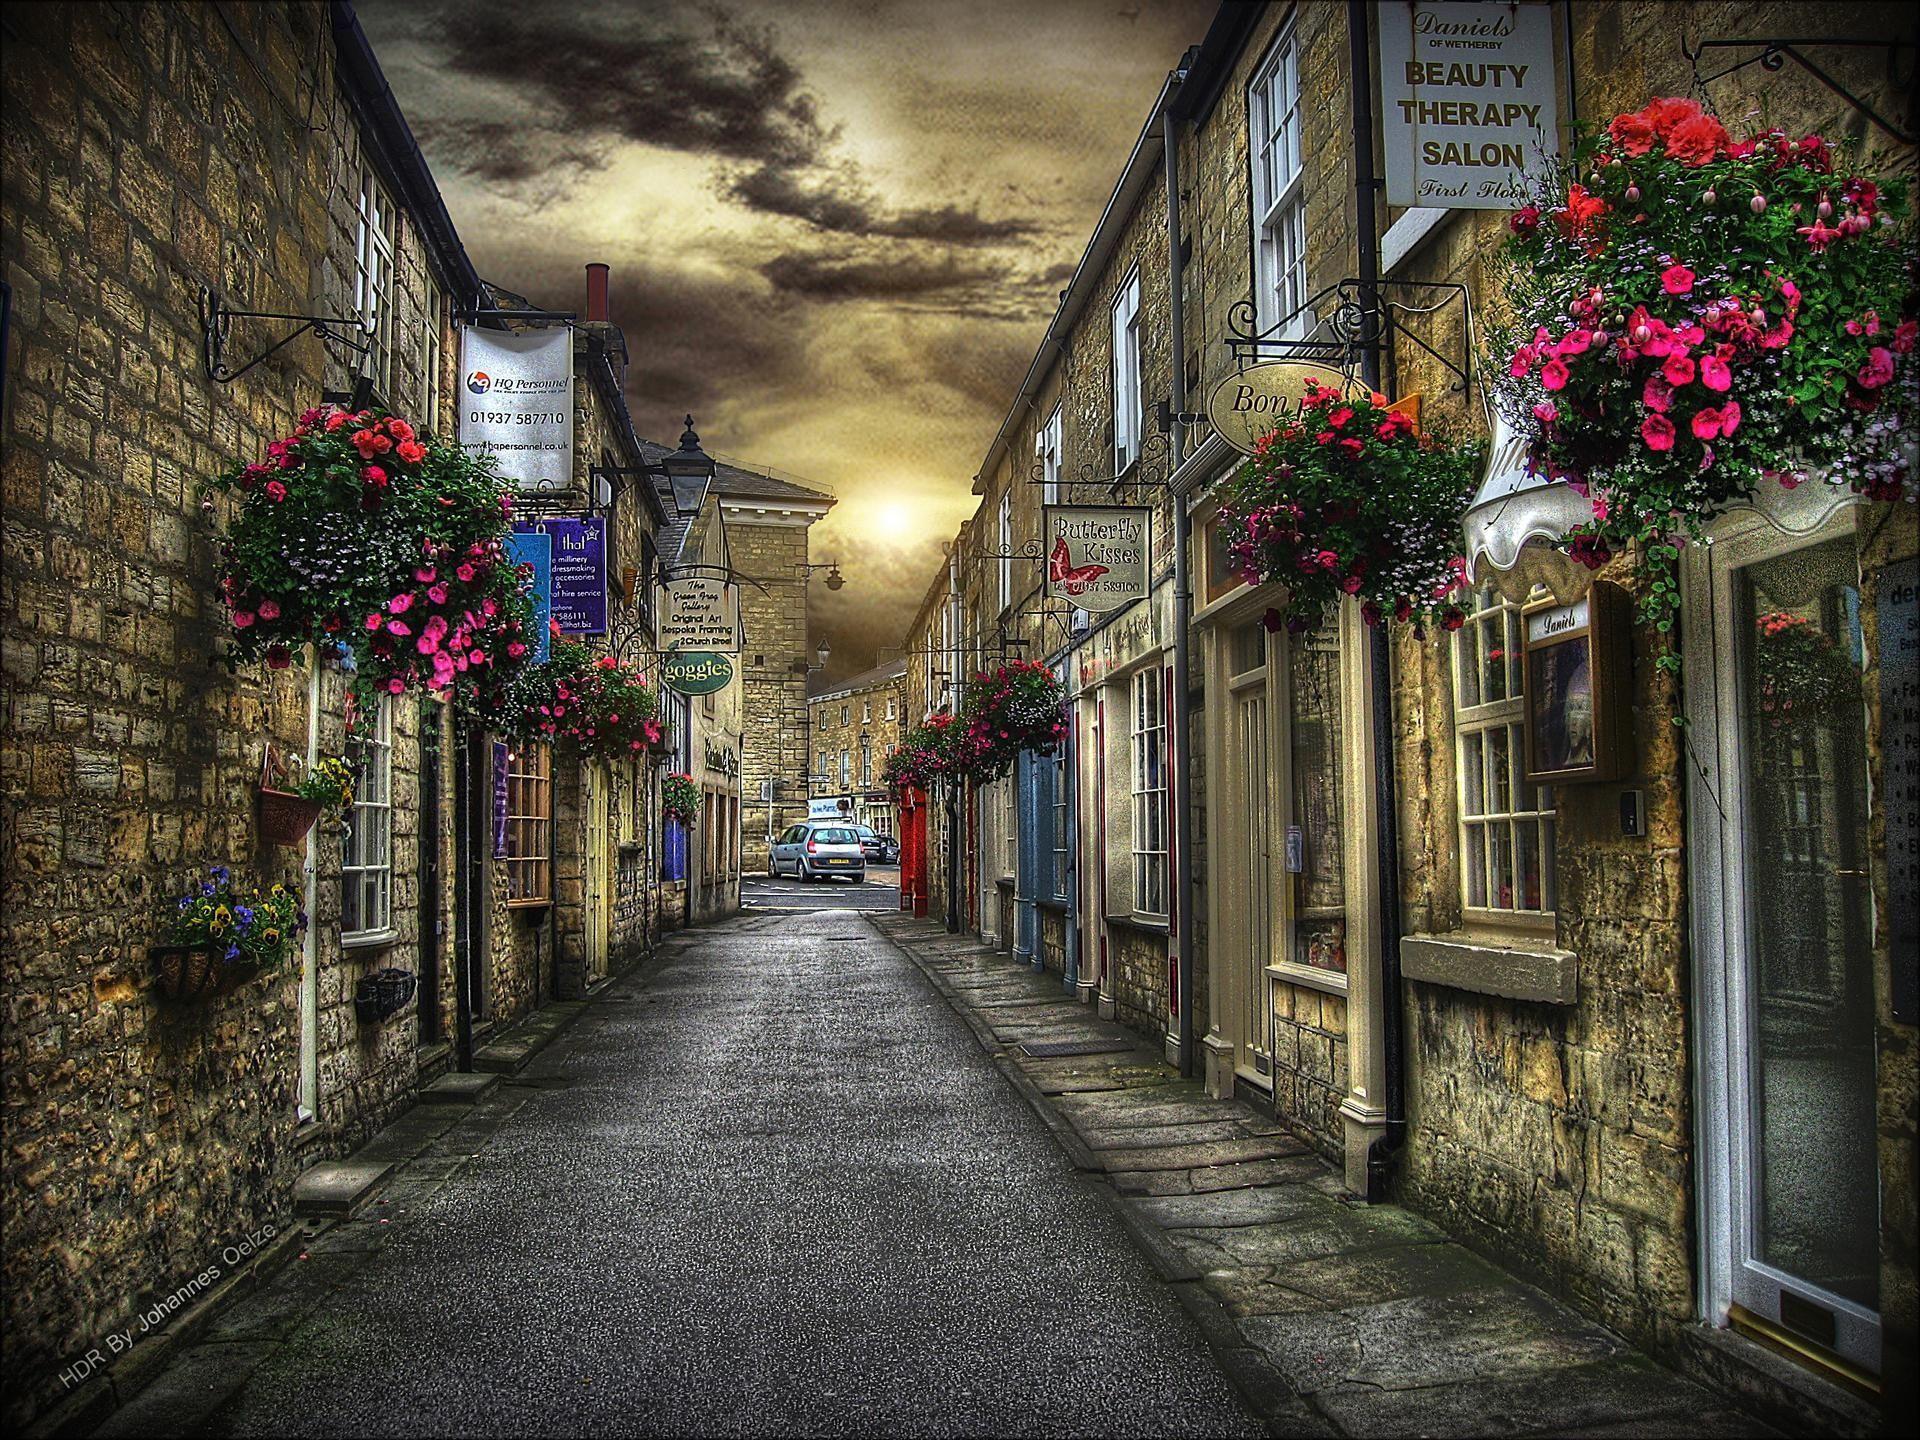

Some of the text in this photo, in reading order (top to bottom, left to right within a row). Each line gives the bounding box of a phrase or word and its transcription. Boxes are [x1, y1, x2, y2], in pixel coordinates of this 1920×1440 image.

[1414, 11, 1516, 37] Daniels
[1429, 39, 1502, 50] OF WETHERBY
[1405, 61, 1529, 88] BEAUTY
[1397, 100, 1541, 127] THERAPY
[1422, 141, 1524, 168] SALON
[1417, 179, 1468, 197] First
[494, 376, 569, 390] HQ Personnel
[1231, 384, 1288, 413] Bon
[470, 412, 564, 425] 01937 587710
[464, 440, 568, 451] wwwhqpersonnel.co.uk
[1054, 516, 1142, 544] Butterfly
[562, 533, 585, 550] that
[558, 555, 588, 564] millinery
[1083, 542, 1141, 565] Kisses
[551, 564, 596, 574] dressmaking
[688, 580, 706, 590] The
[1103, 581, 1140, 592] 589100
[551, 590, 560, 598] at
[673, 591, 719, 602] Green Frog
[681, 601, 711, 612] Gallery
[672, 614, 722, 624] Original Art
[1544, 609, 1576, 634] Daniels
[661, 625, 733, 635] Bespoke Framing
[680, 637, 732, 645] 2 Church Street
[664, 660, 732, 682] goggies
